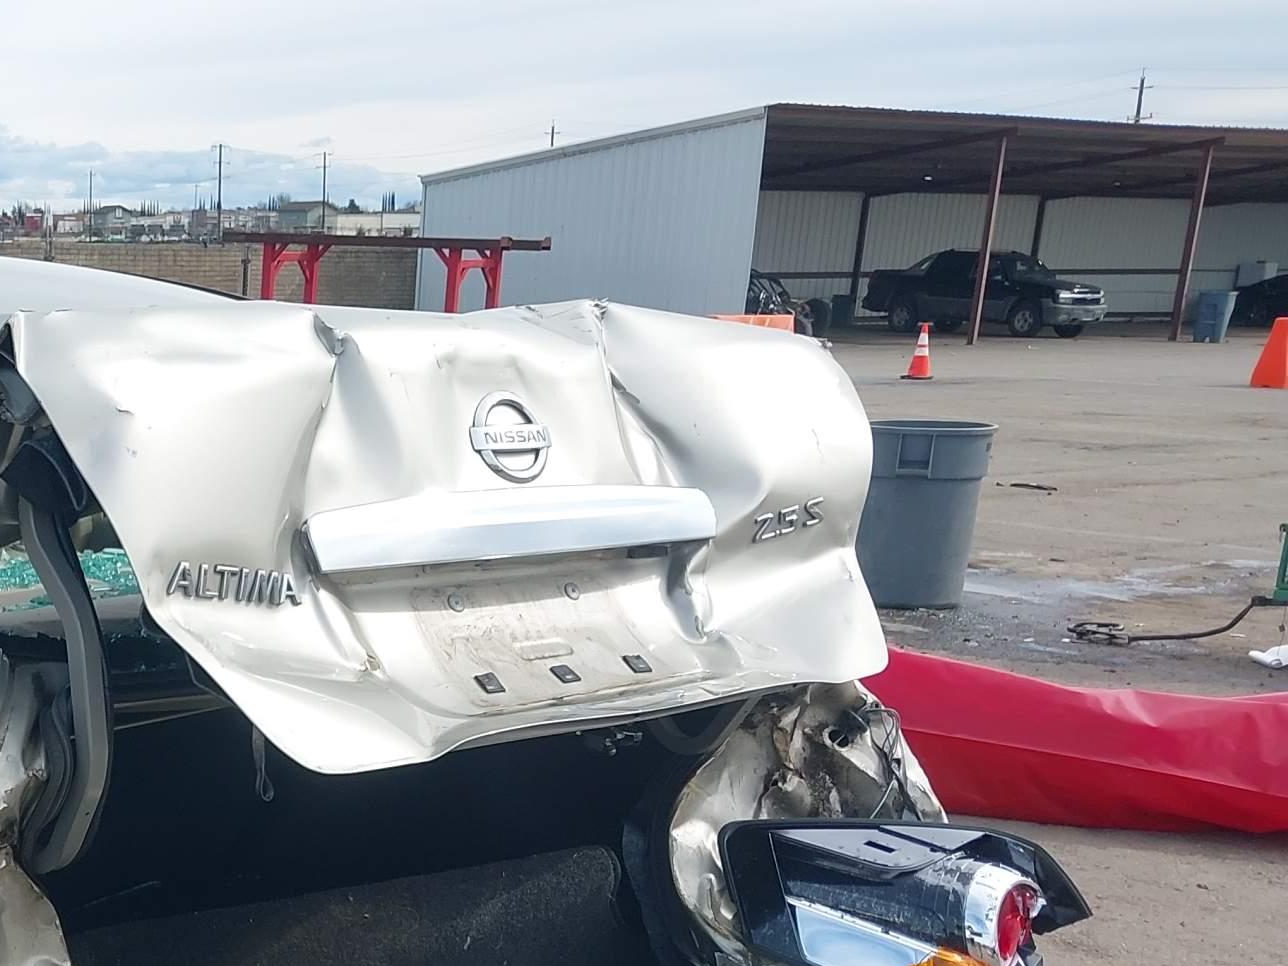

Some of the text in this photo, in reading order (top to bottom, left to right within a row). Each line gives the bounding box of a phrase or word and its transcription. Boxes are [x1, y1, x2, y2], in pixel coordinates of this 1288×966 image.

[483, 429, 547, 444] NISSAN
[802, 496, 824, 528] S
[167, 560, 302, 608] ALTIMA
